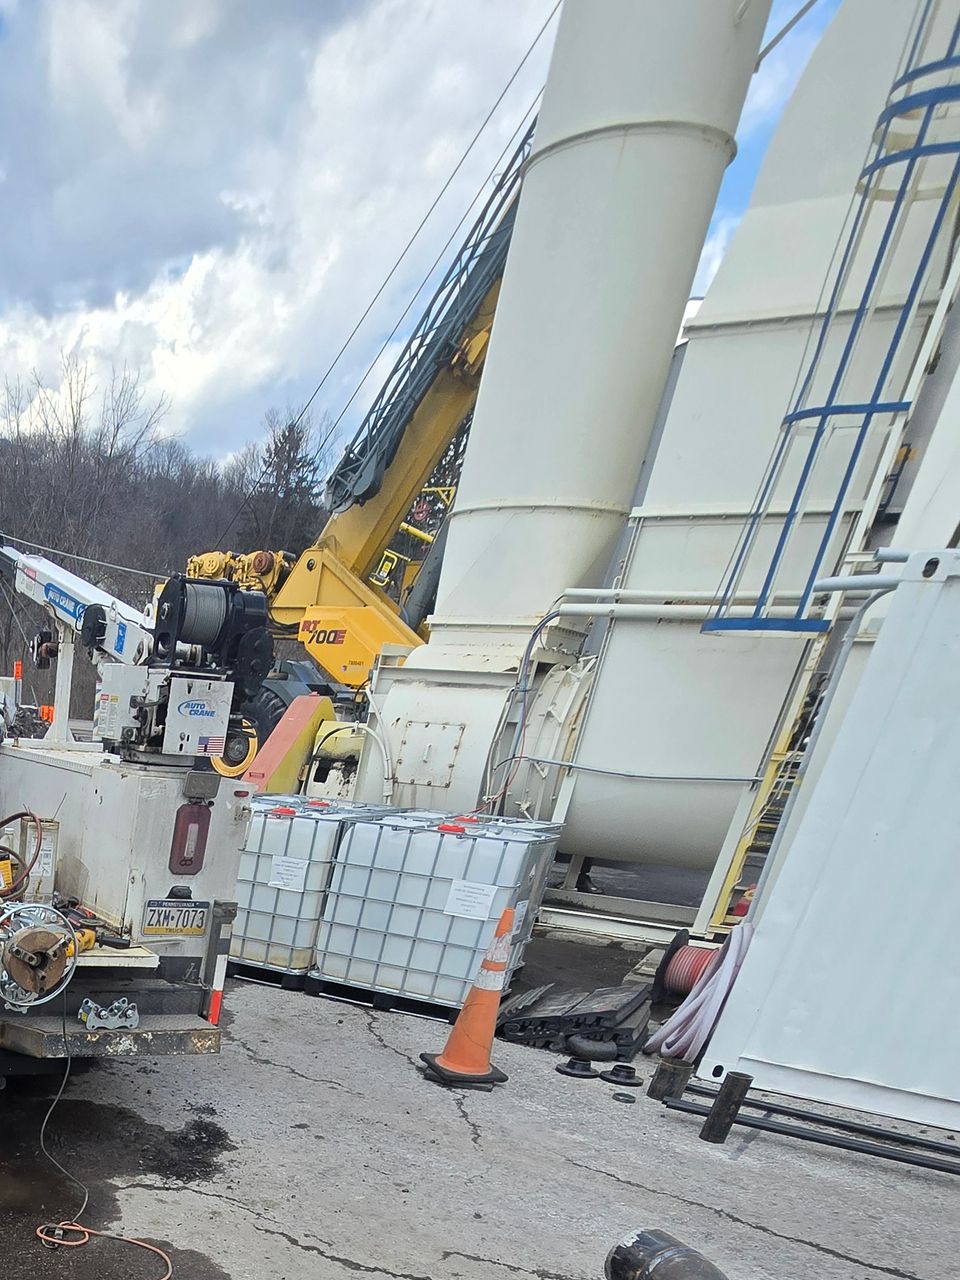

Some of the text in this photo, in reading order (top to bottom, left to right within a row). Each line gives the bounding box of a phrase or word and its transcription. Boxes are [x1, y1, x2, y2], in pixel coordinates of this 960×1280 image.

[301, 620, 321, 632] RT
[308, 629, 347, 645] 700E
[184, 702, 206, 710] AUTO
[189, 709, 216, 717] CRANE
